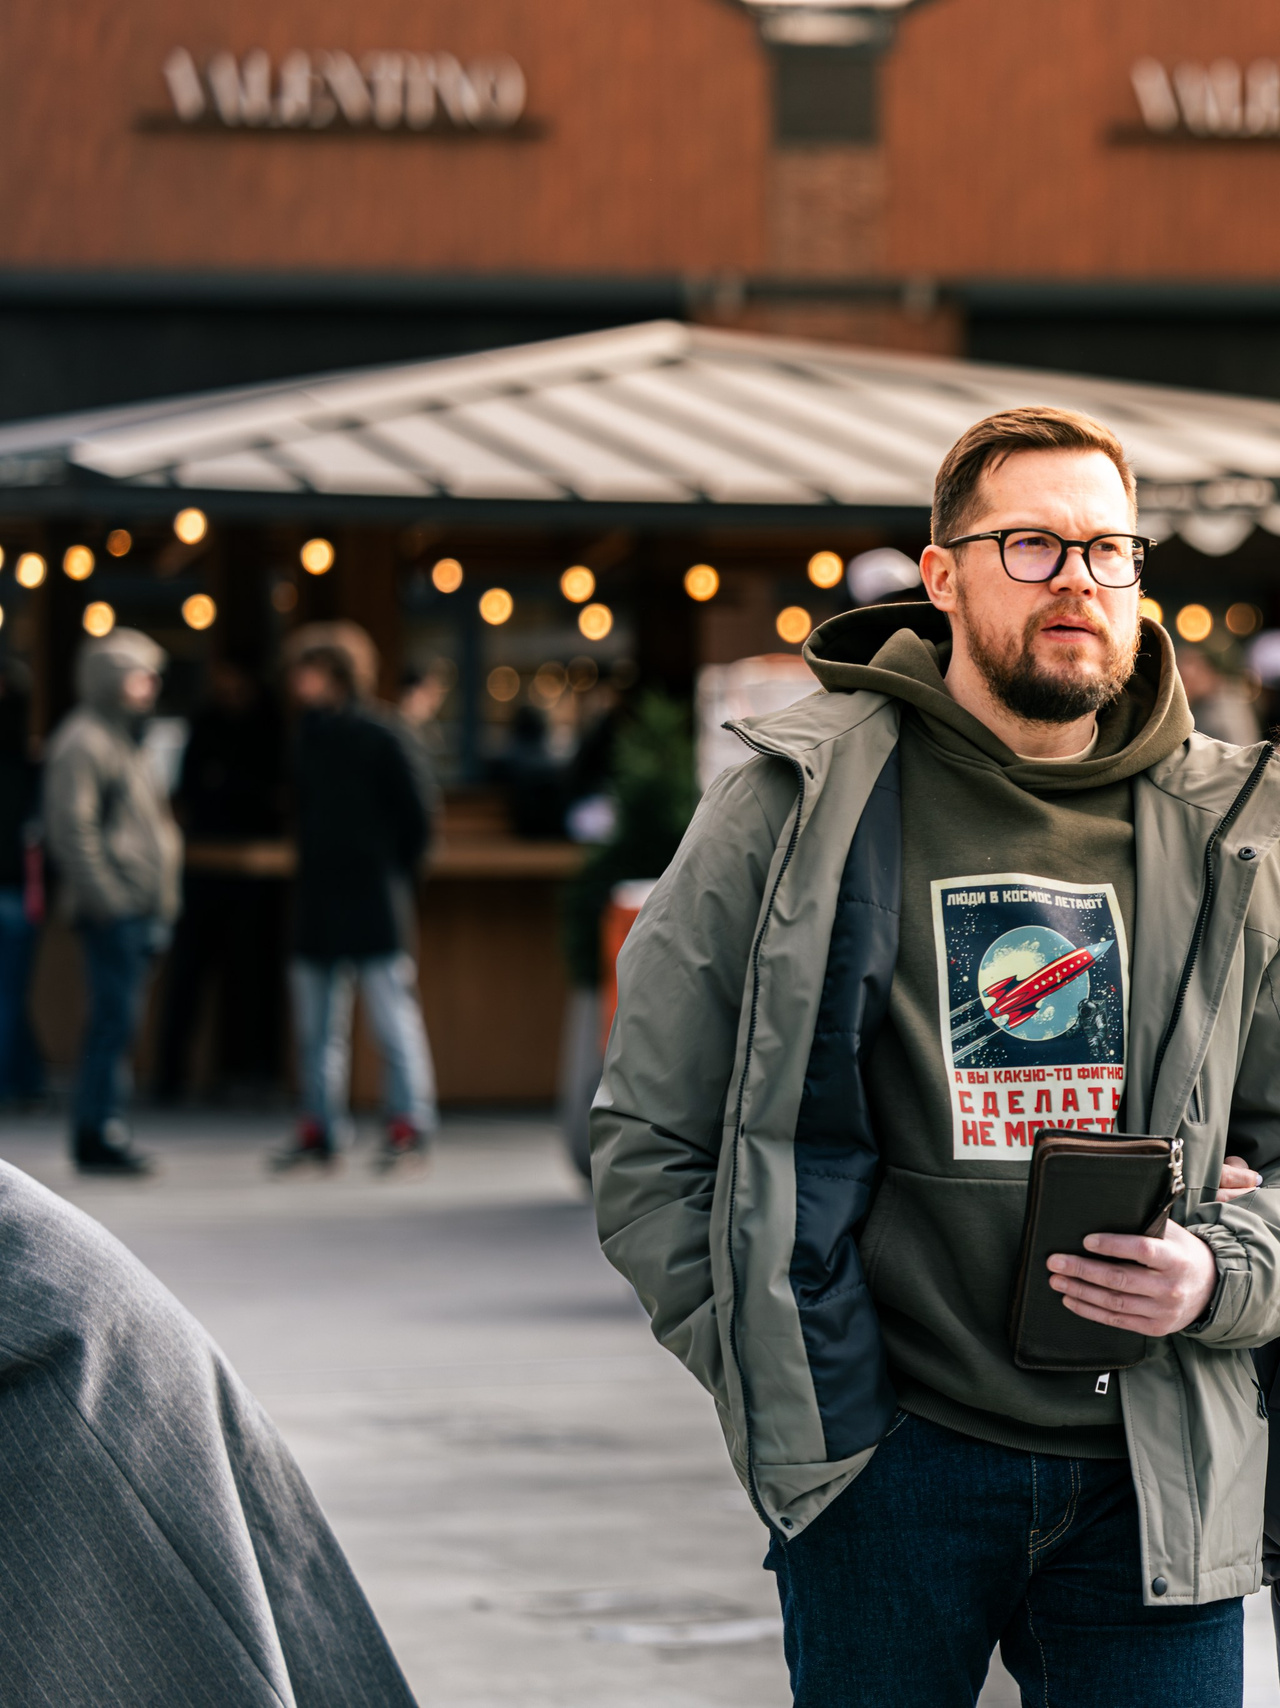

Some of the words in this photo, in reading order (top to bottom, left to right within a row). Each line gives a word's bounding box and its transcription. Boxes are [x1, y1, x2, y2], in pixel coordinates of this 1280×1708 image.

[946, 892, 986, 906] ЛЮДИ
[990, 891, 999, 903] В
[1003, 890, 1052, 904] КОСМОС
[1055, 895, 1103, 909] ЛЕТАЮТ
[955, 1071, 963, 1083] А
[967, 1071, 989, 1084] ВЫ
[994, 1068, 1072, 1083] КАКУЮ-ТО
[1077, 1067, 1123, 1080] ФИГНЮ
[958, 1087, 1120, 1118] СДЕЛАТЬ
[962, 1120, 996, 1146] НЕ
